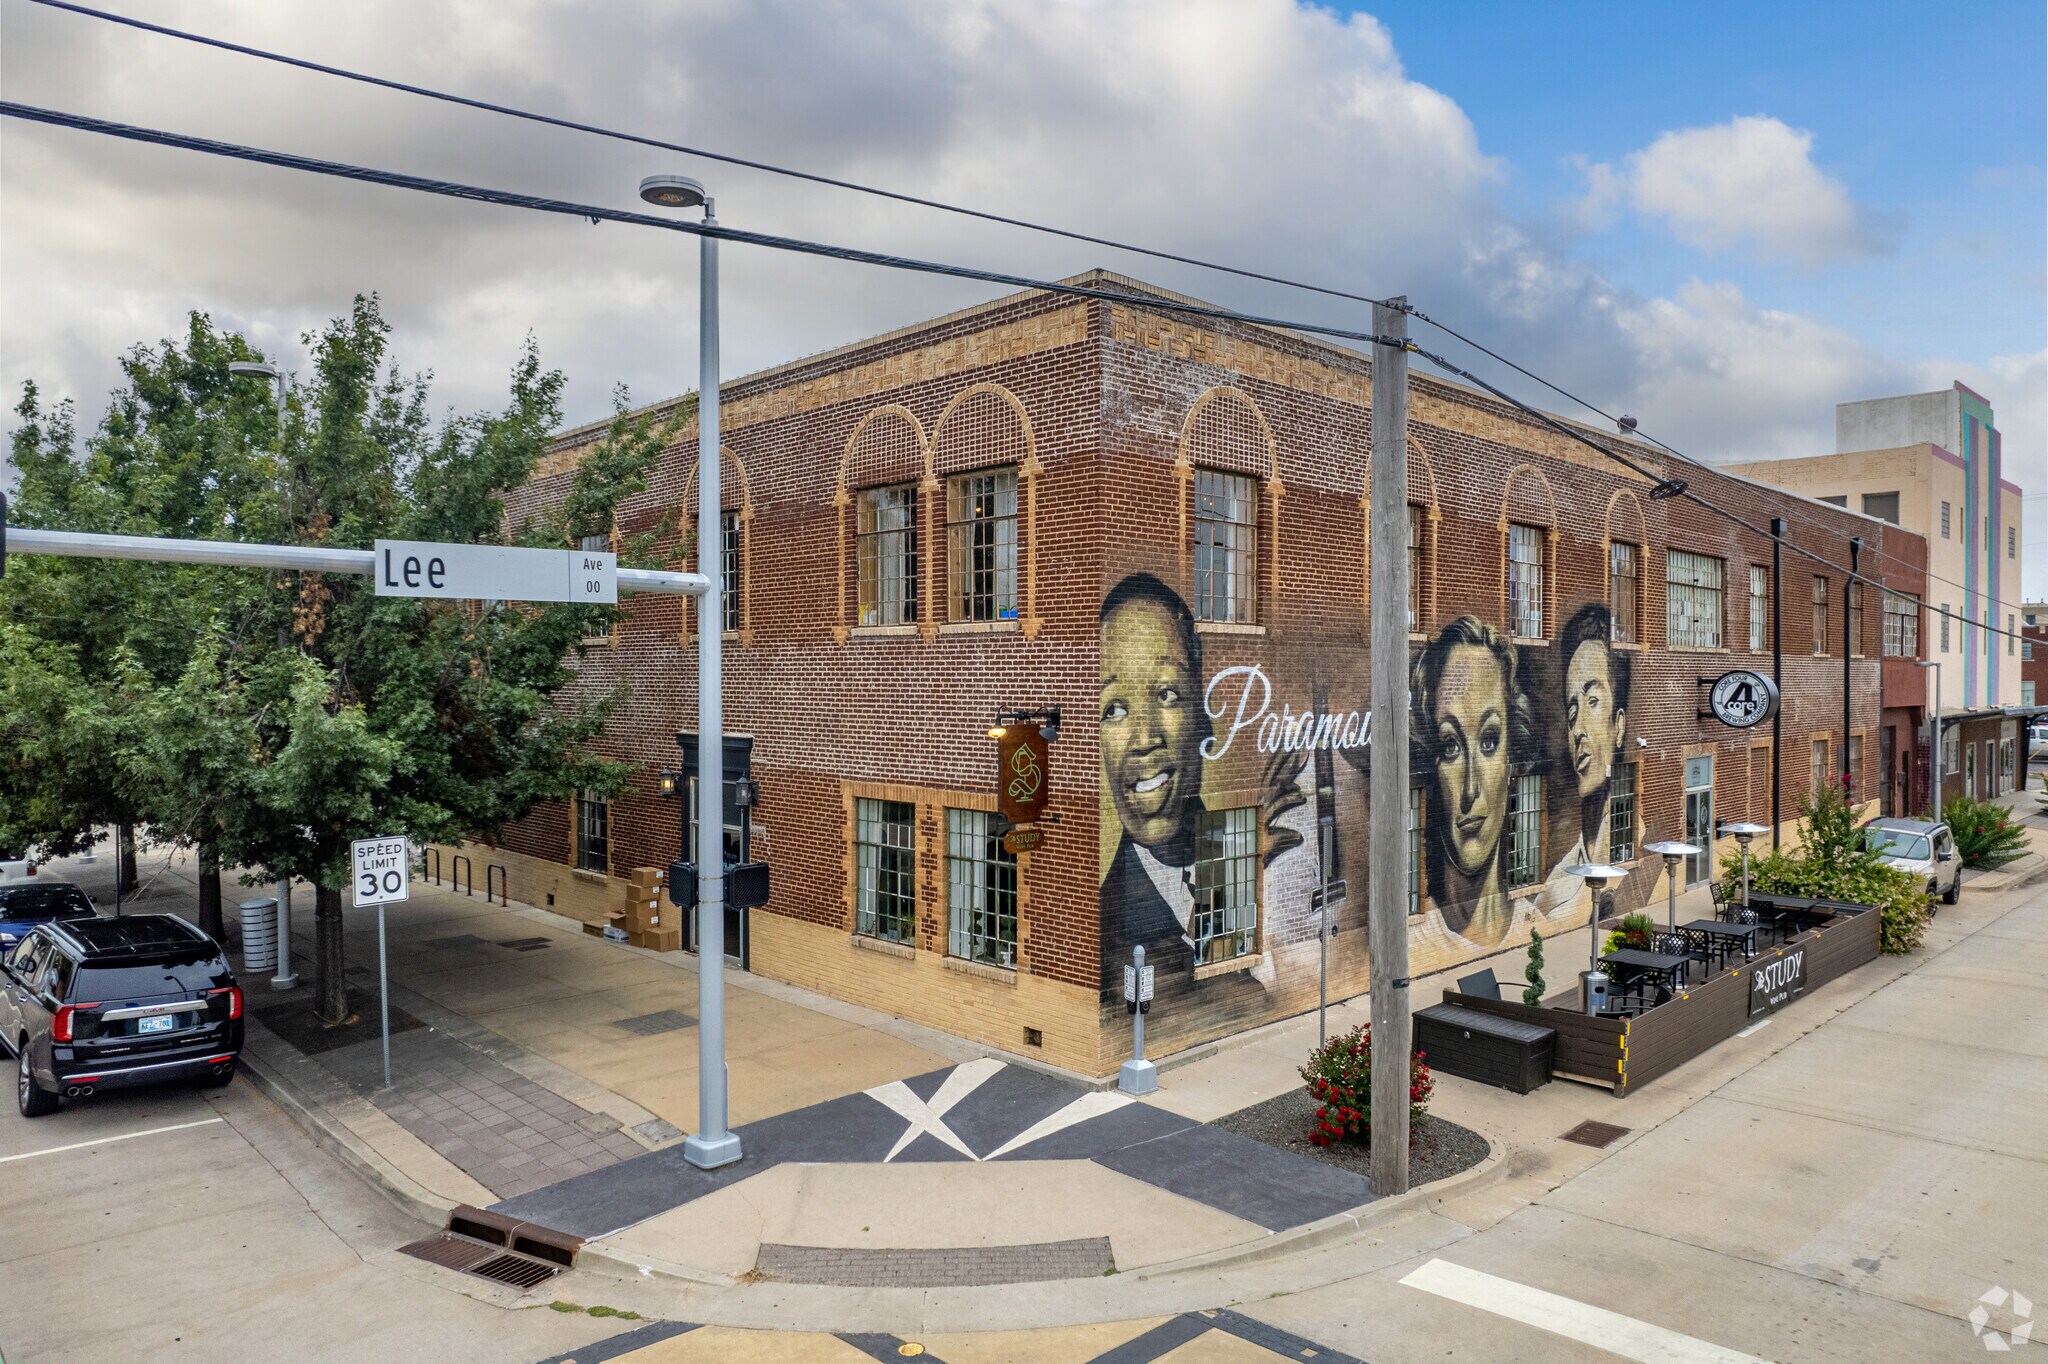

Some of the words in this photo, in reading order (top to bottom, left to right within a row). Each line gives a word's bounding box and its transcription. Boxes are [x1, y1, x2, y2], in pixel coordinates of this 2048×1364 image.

[384, 548, 446, 589] Lee
[583, 557, 603, 571] Ave
[586, 580, 601, 593] 00
[1718, 678, 1731, 691] CORE
[1199, 663, 1373, 761] Paramou
[1721, 712, 1750, 724] BREWING
[1750, 693, 1766, 721] COMPANY
[1727, 700, 1755, 711] core
[1016, 832, 1040, 844] STUDY
[357, 844, 402, 858] SPEED
[362, 857, 397, 870] LIMIT
[360, 870, 402, 897] 30
[1764, 951, 1803, 994] STUDY
